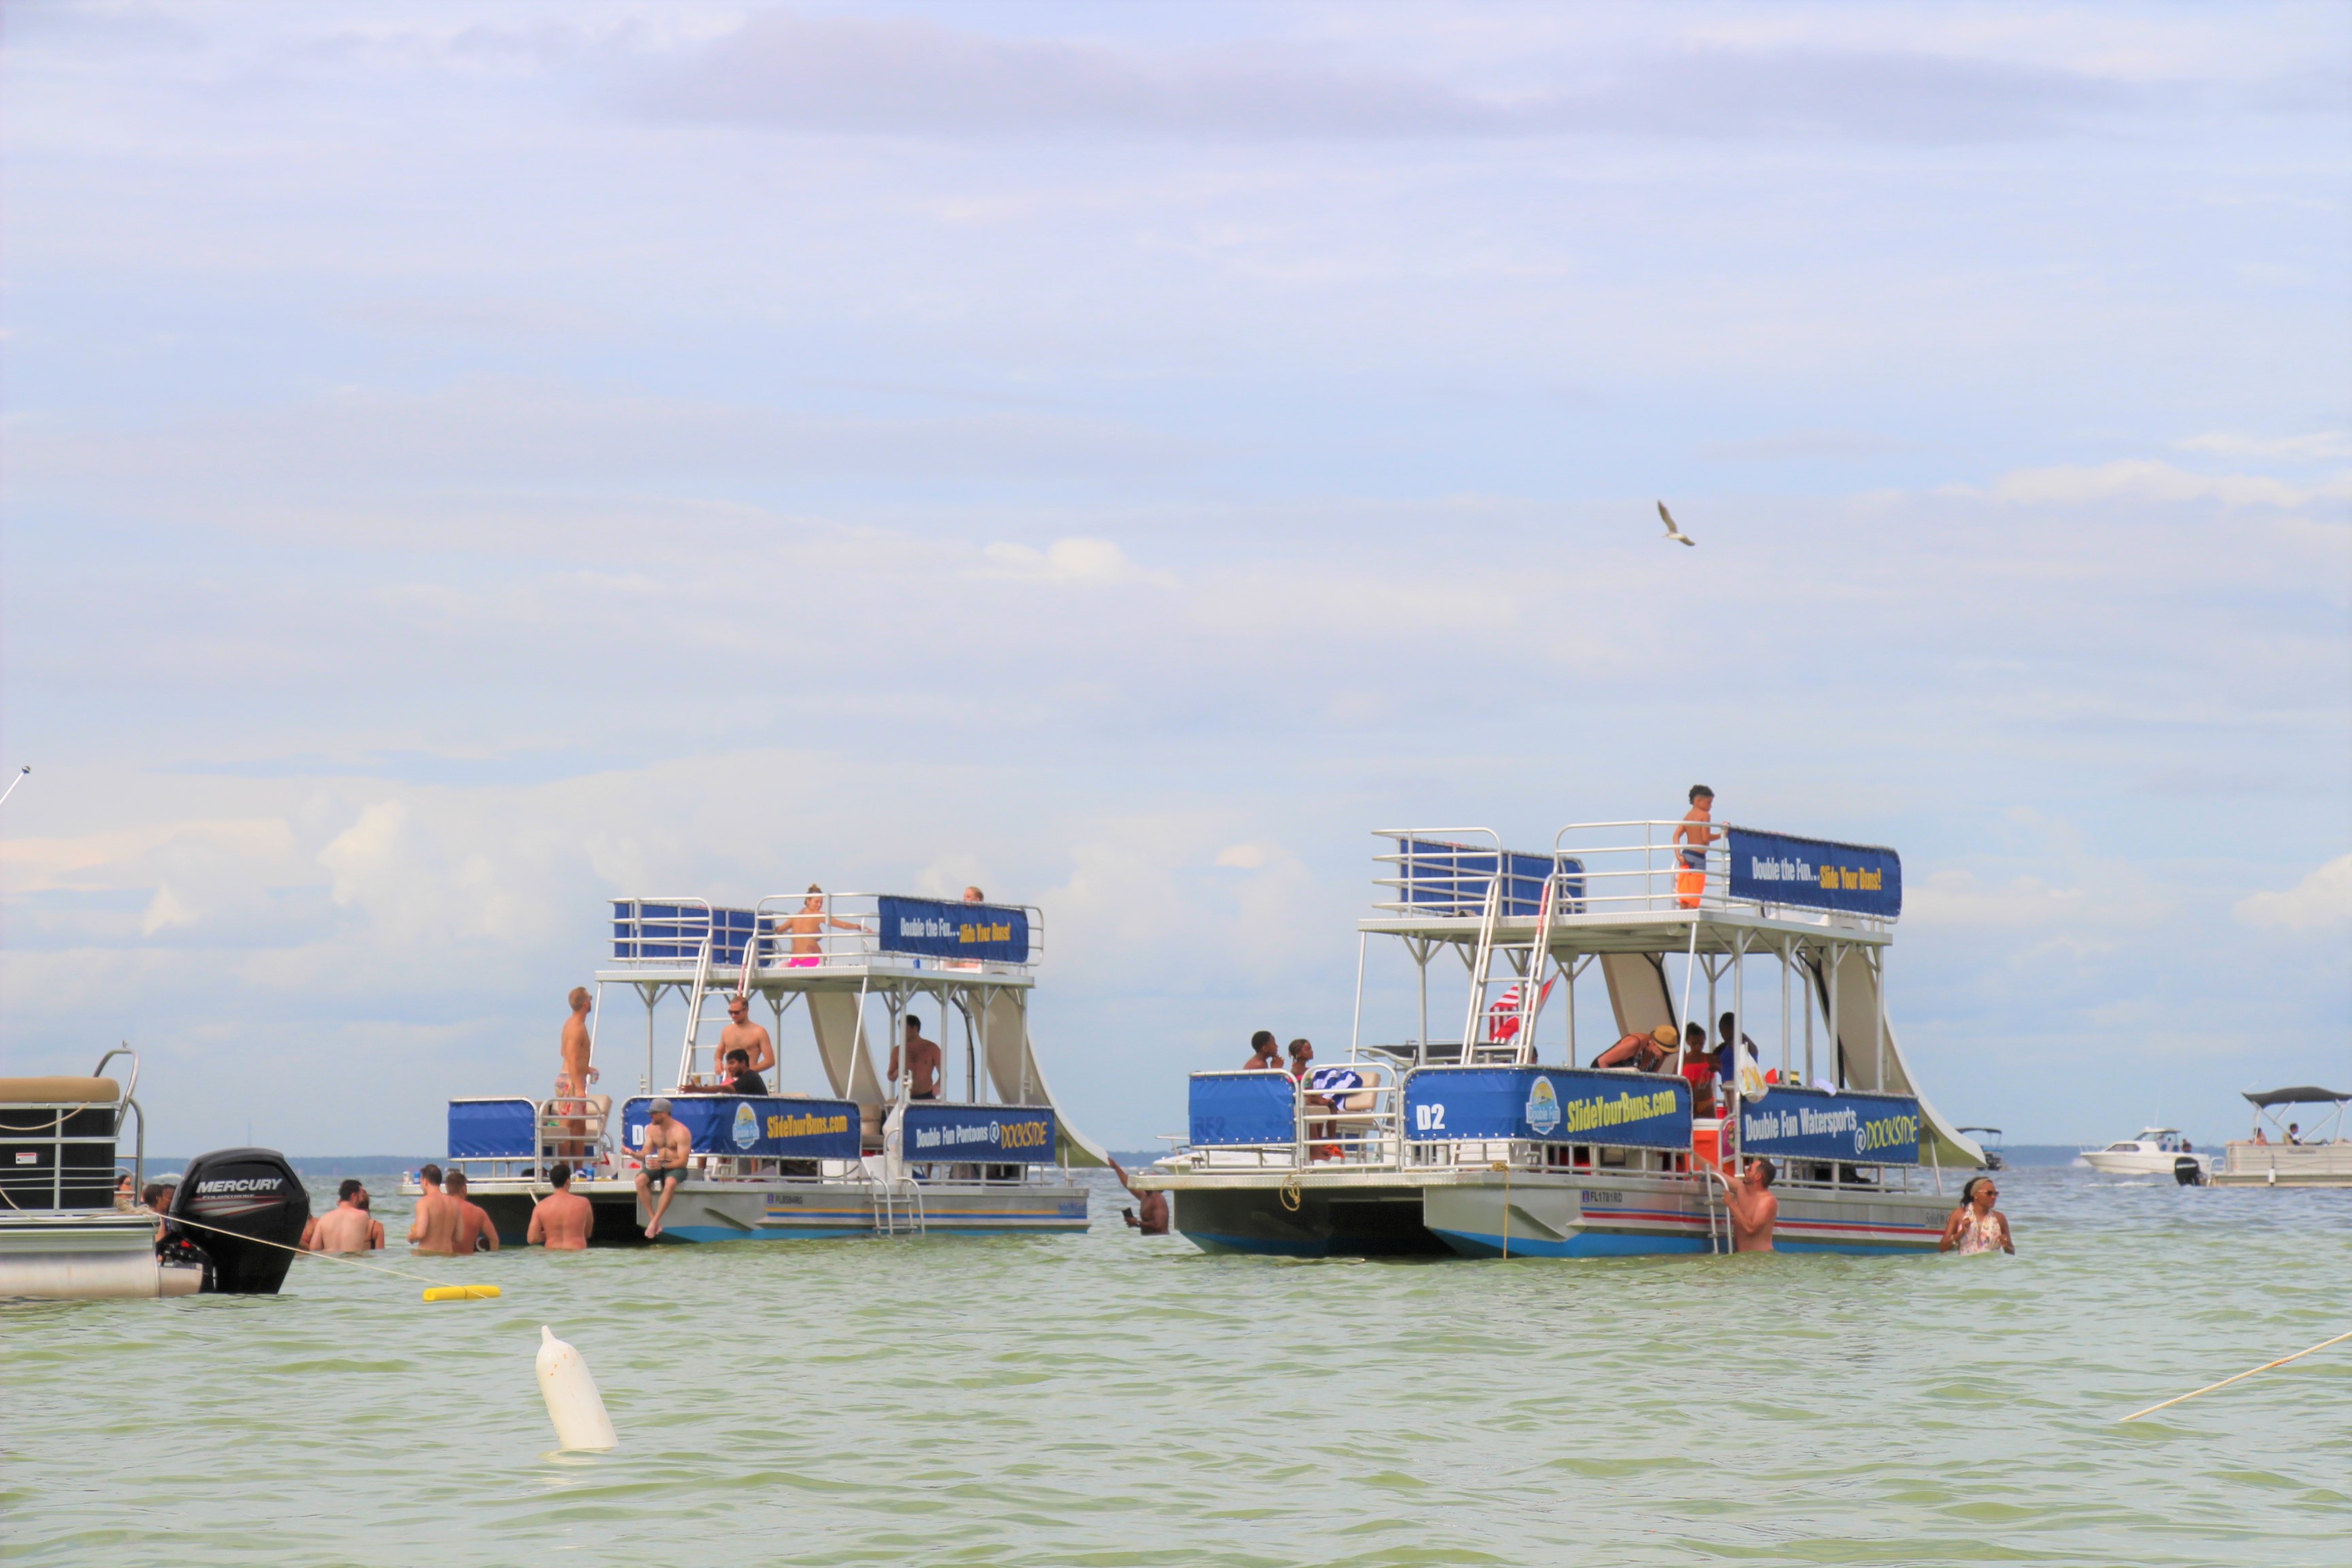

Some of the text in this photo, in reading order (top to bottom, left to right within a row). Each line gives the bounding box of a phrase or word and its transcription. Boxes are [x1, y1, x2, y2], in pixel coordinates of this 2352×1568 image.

[1752, 856, 1780, 880] Double
[1781, 858, 1795, 881] the
[1820, 865, 1882, 890] Slide Your Buns!
[900, 917, 924, 937] Double
[926, 919, 938, 937] the
[960, 922, 1011, 943] Slide Your Buns!
[1416, 1103, 1445, 1130] D2
[1567, 1090, 1677, 1133] SlideYourBuns.com
[1745, 1107, 1857, 1141] Double Fun Watersports
[767, 1113, 848, 1139] SlideYourBuns.com
[916, 1127, 941, 1148] Double
[943, 1126, 955, 1145] Fun
[956, 1124, 988, 1144] Pontoons
[1000, 1121, 1047, 1149] DOCKSIDE
[196, 1178, 283, 1193] MERCURY
